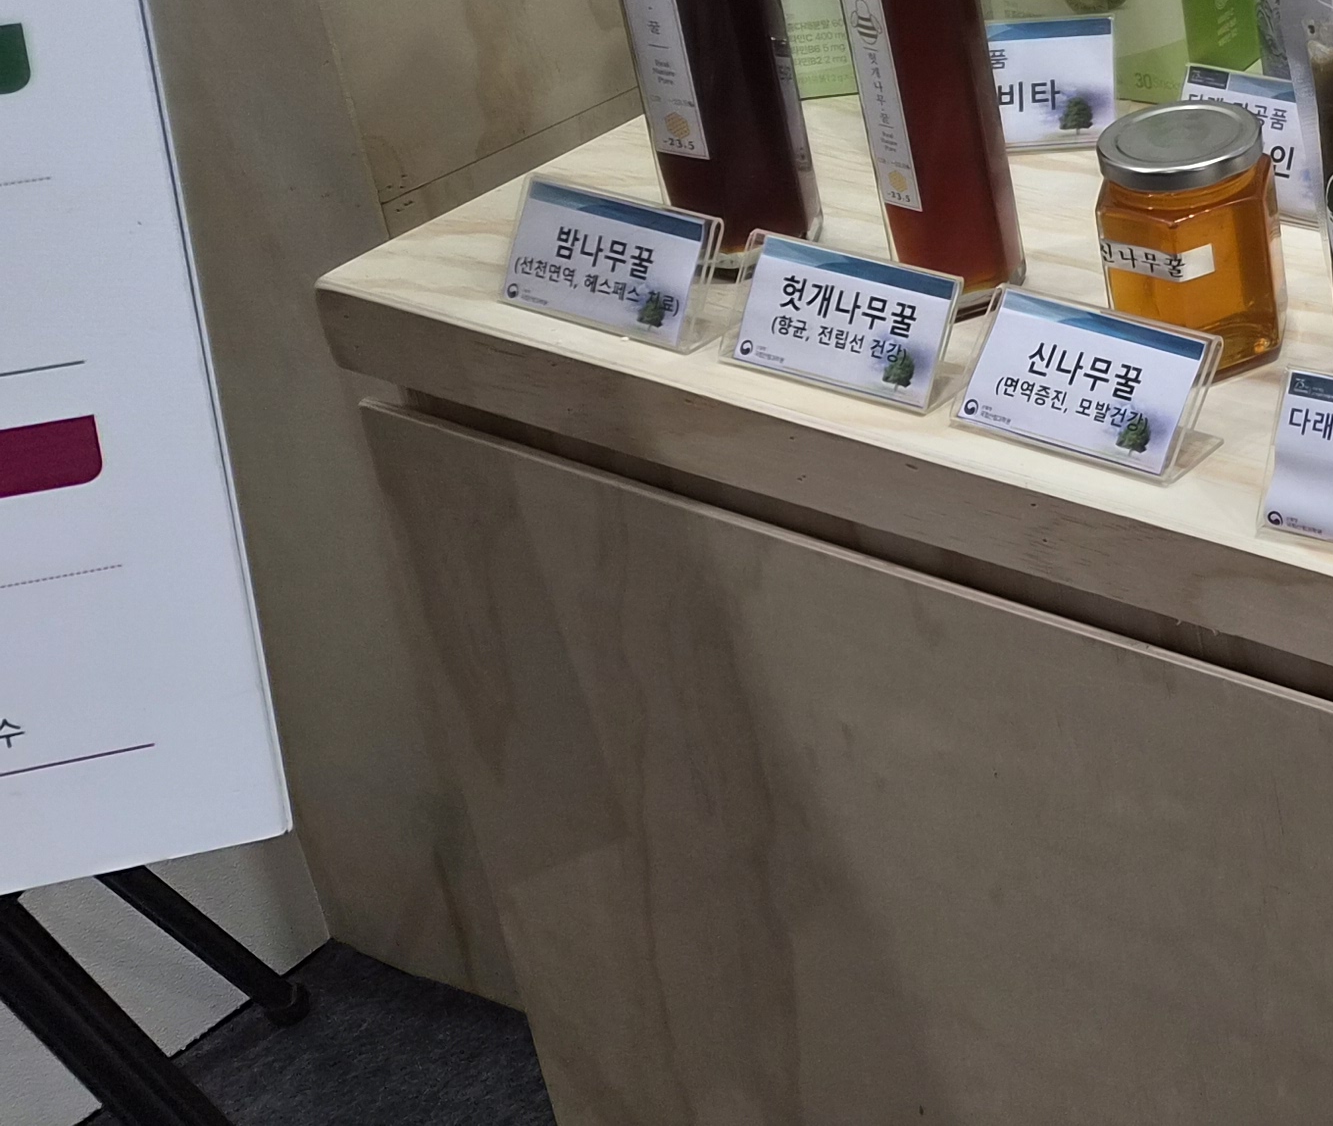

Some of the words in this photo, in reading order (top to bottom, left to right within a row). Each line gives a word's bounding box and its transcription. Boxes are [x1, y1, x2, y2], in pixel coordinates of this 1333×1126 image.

[1135, 72, 1152, 90] 30
[555, 225, 655, 281] 밤나무꿀
[1100, 242, 1186, 279] 신나무꿀
[514, 257, 578, 289] (선천면역,
[647, 290, 680, 317] 치료)
[779, 274, 917, 339] 헛개나무꿀
[817, 325, 865, 354] 전립선
[870, 338, 907, 365] 건강)
[1027, 340, 1143, 403] 신나무꿀
[995, 375, 1069, 415] (면역증진,
[1075, 394, 1149, 432] 모발건강)
